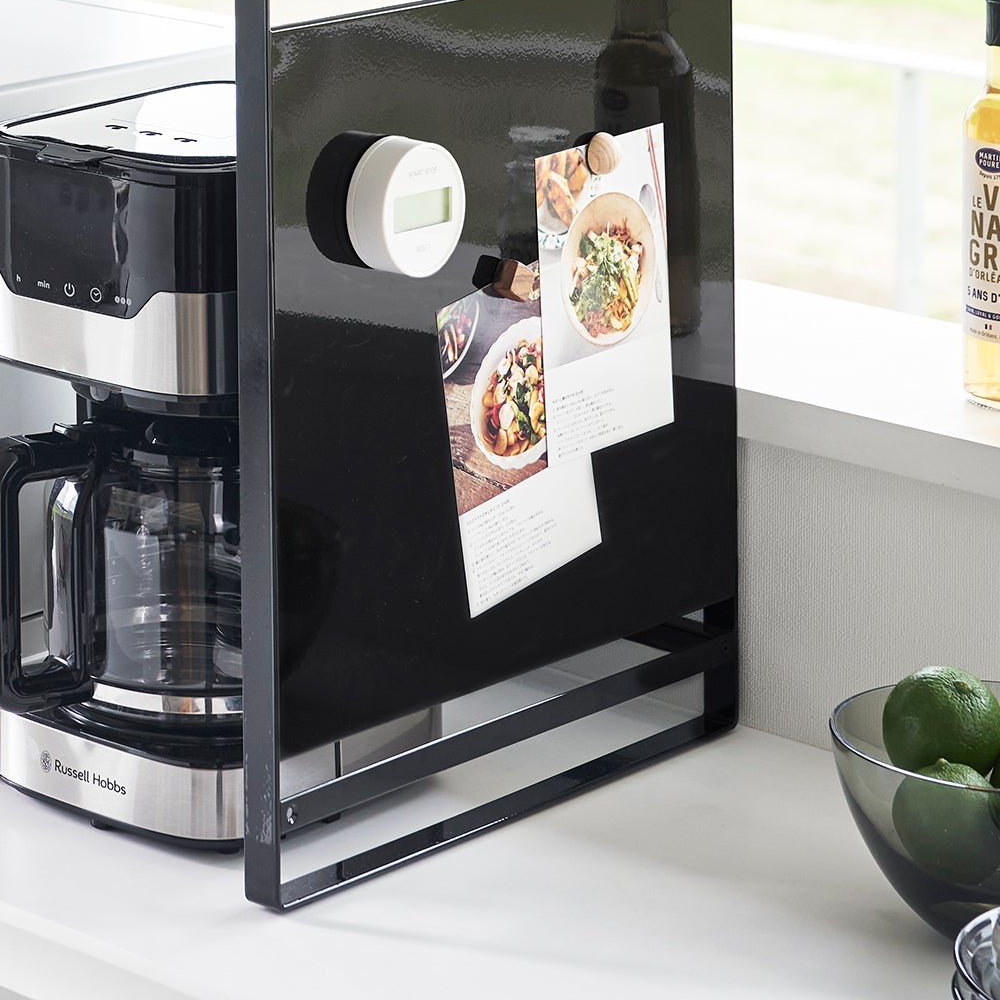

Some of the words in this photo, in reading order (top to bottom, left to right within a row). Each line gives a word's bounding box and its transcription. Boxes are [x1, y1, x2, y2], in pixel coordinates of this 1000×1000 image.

[978, 151, 1000, 161] MARTI
[971, 195, 982, 209] LE
[983, 183, 1000, 212] V
[971, 209, 1000, 241] NA
[969, 237, 999, 271] GR
[16, 274, 21, 282] h
[37, 280, 51, 290] min
[972, 287, 989, 302] ANS
[54, 758, 90, 784] Russell
[92, 772, 127, 796] Hobbs
